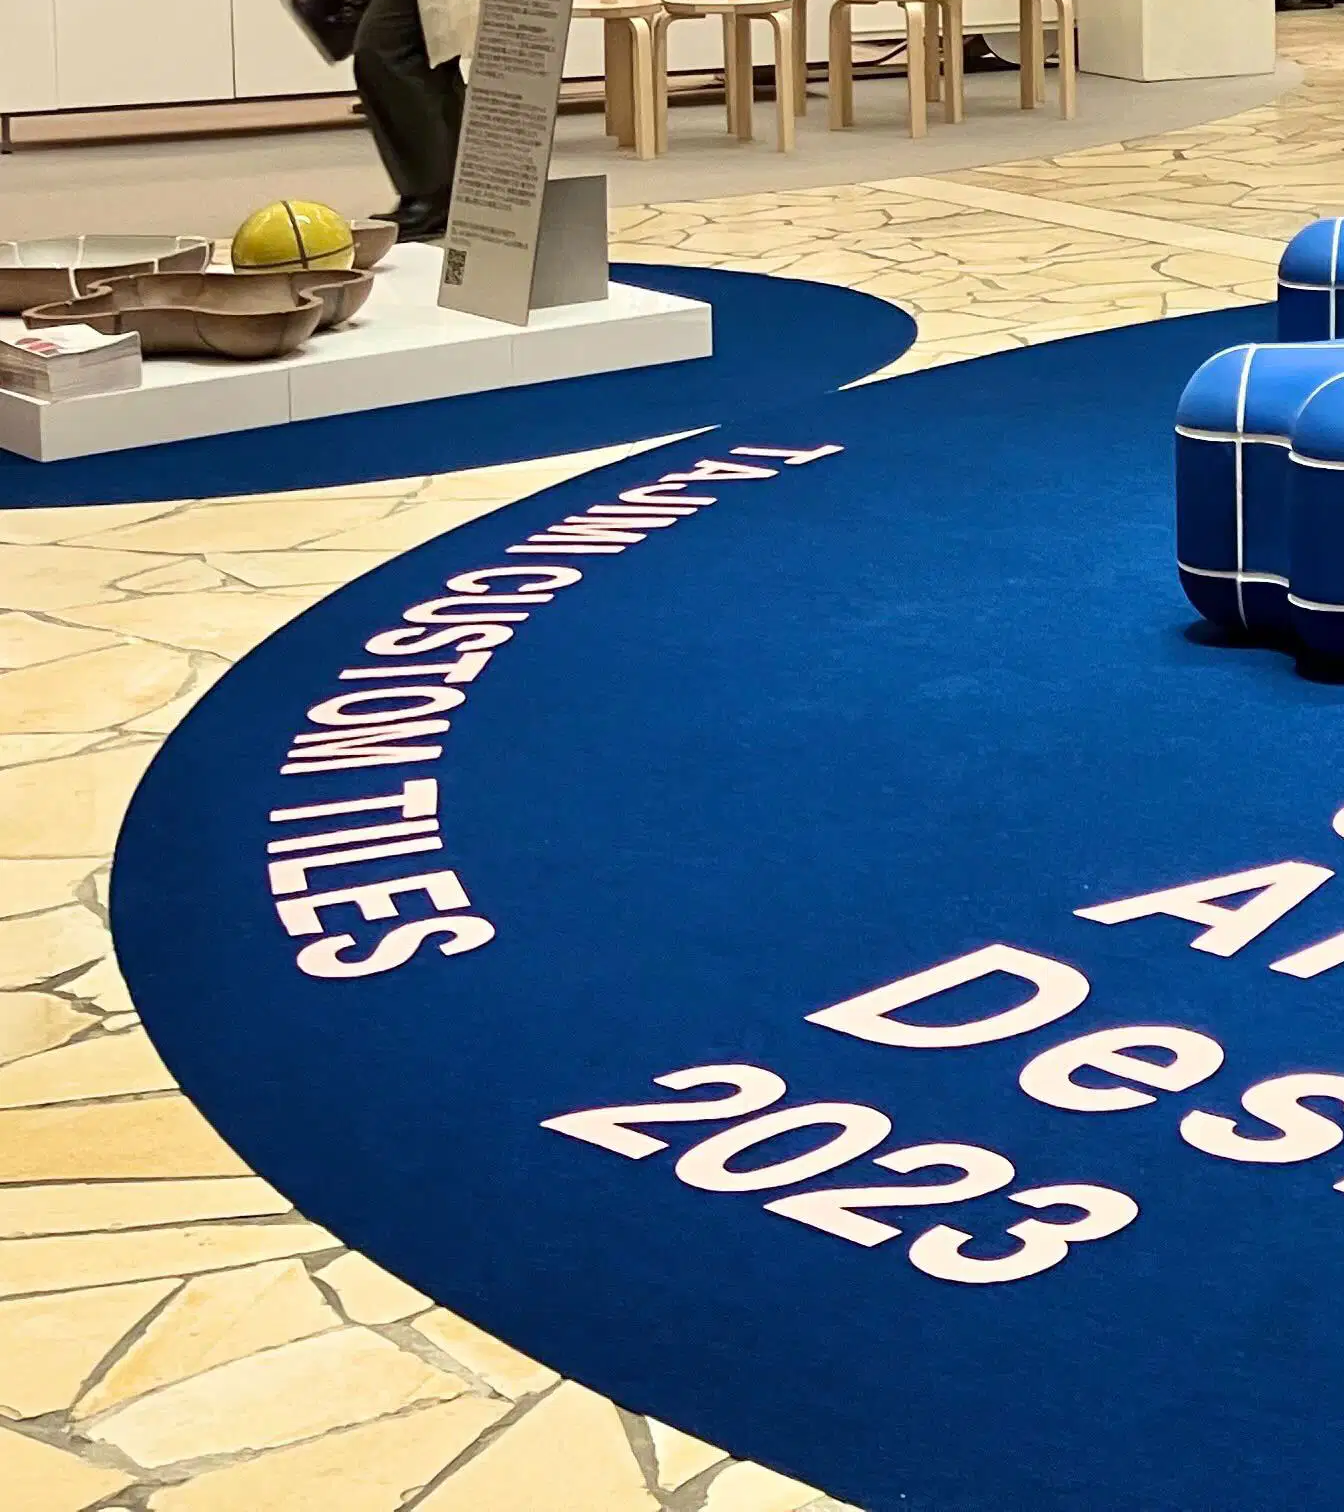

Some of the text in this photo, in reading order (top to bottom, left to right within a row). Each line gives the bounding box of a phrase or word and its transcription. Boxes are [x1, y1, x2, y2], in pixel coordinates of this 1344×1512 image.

[266, 443, 846, 978] TAJIMI CUSTOM TILES
[538, 1063, 1140, 1285] 2023
